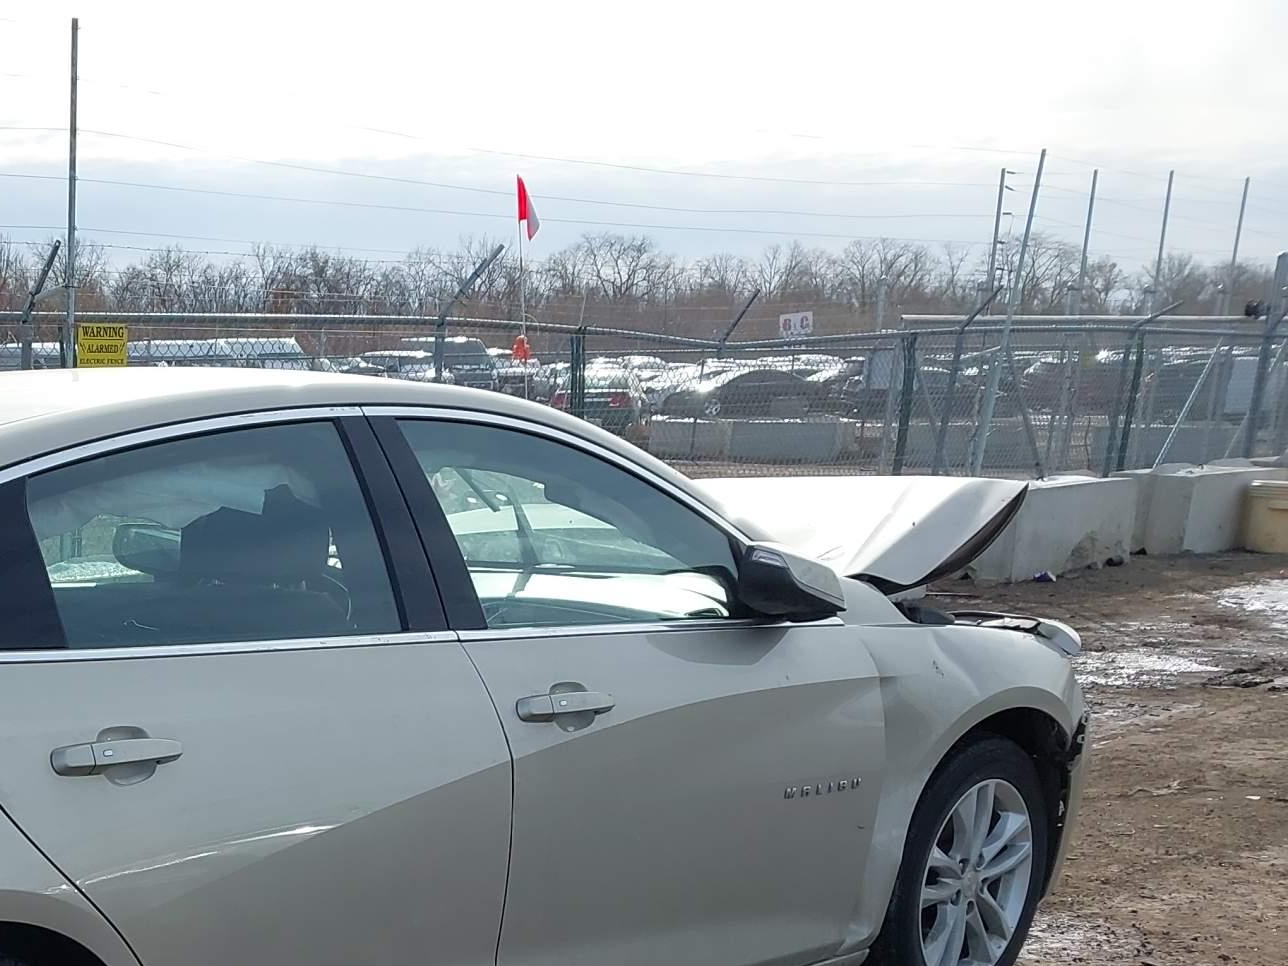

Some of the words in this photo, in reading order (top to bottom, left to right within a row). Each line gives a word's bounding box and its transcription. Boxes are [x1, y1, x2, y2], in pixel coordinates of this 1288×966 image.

[82, 326, 125, 338] WARNING
[87, 343, 119, 353] ALARMED
[784, 778, 861, 799] MALIBU
